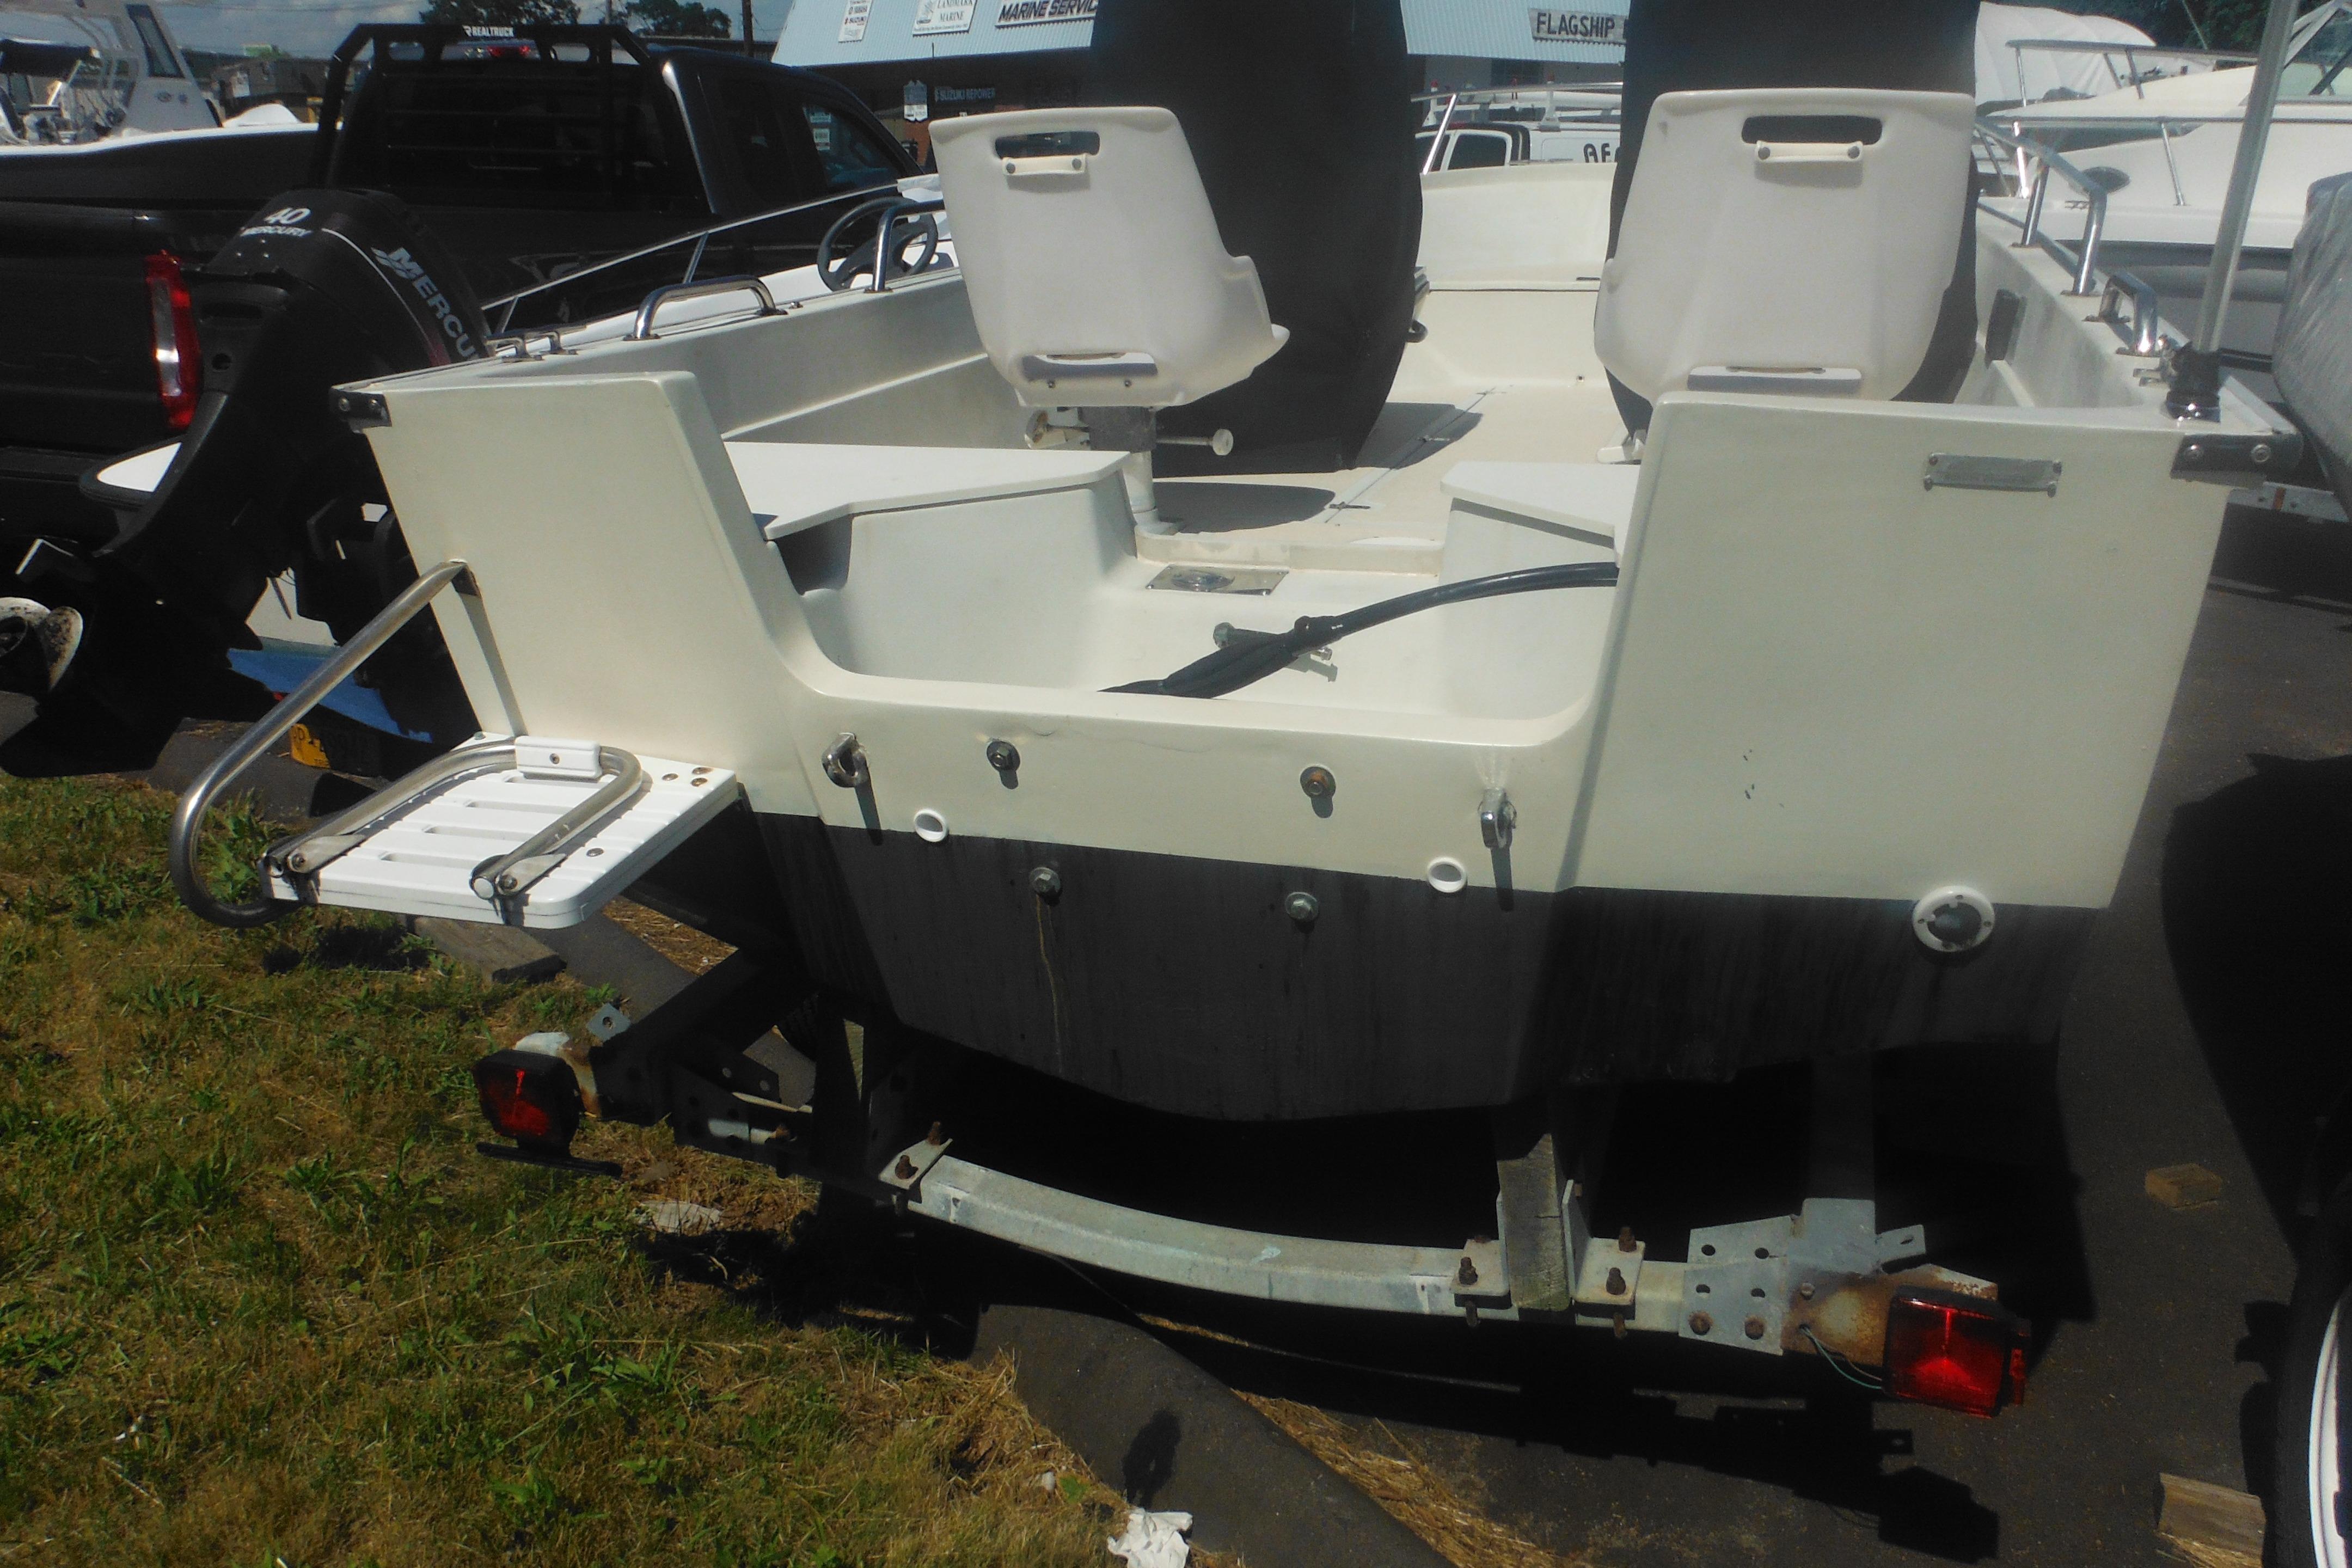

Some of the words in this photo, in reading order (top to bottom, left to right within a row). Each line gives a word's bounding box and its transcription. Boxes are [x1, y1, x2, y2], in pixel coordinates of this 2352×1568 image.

[998, 1, 1048, 22] MARINE
[1537, 12, 1615, 38] FLAGSHIP
[264, 207, 311, 224] 40
[240, 225, 313, 236] MERCURY
